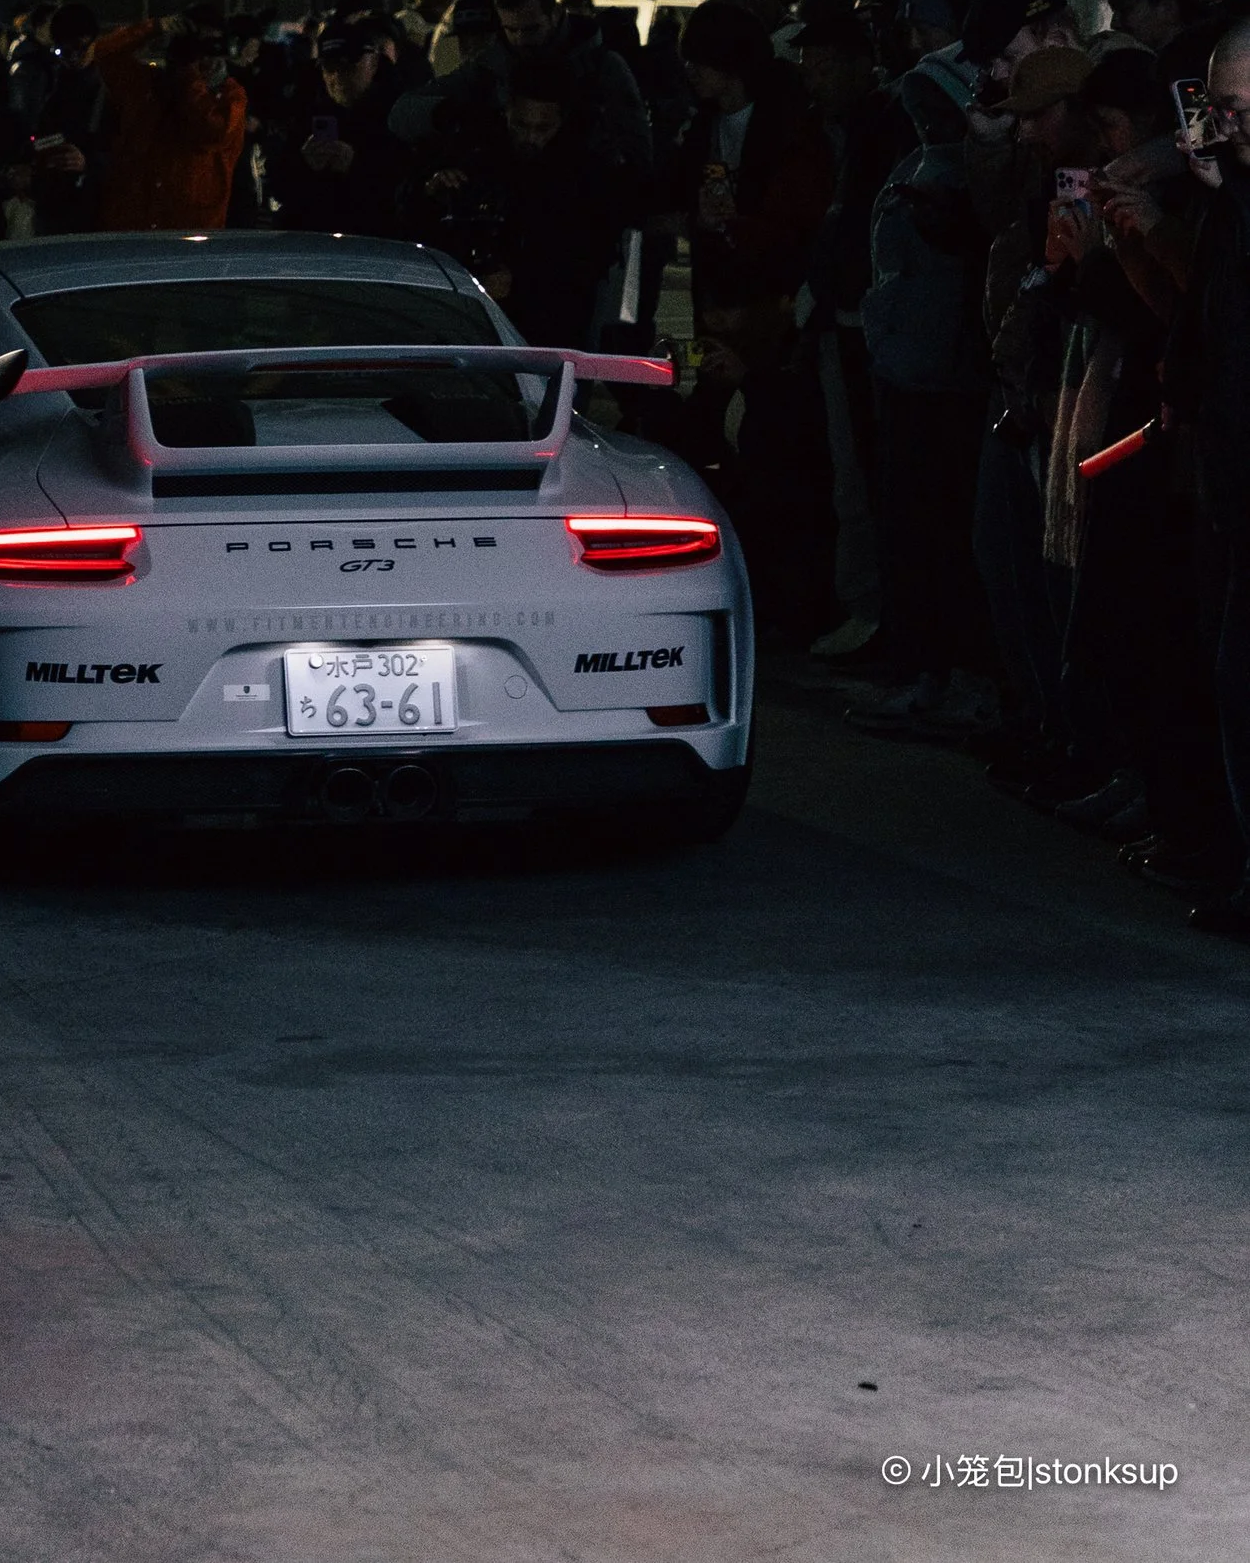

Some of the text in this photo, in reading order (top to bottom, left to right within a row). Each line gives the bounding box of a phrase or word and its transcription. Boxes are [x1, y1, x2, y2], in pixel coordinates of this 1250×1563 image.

[226, 537, 497, 553] PORSCHE
[339, 559, 395, 572] GT3
[326, 654, 420, 678] 水戸 302
[299, 681, 443, 727] ち 63-61
